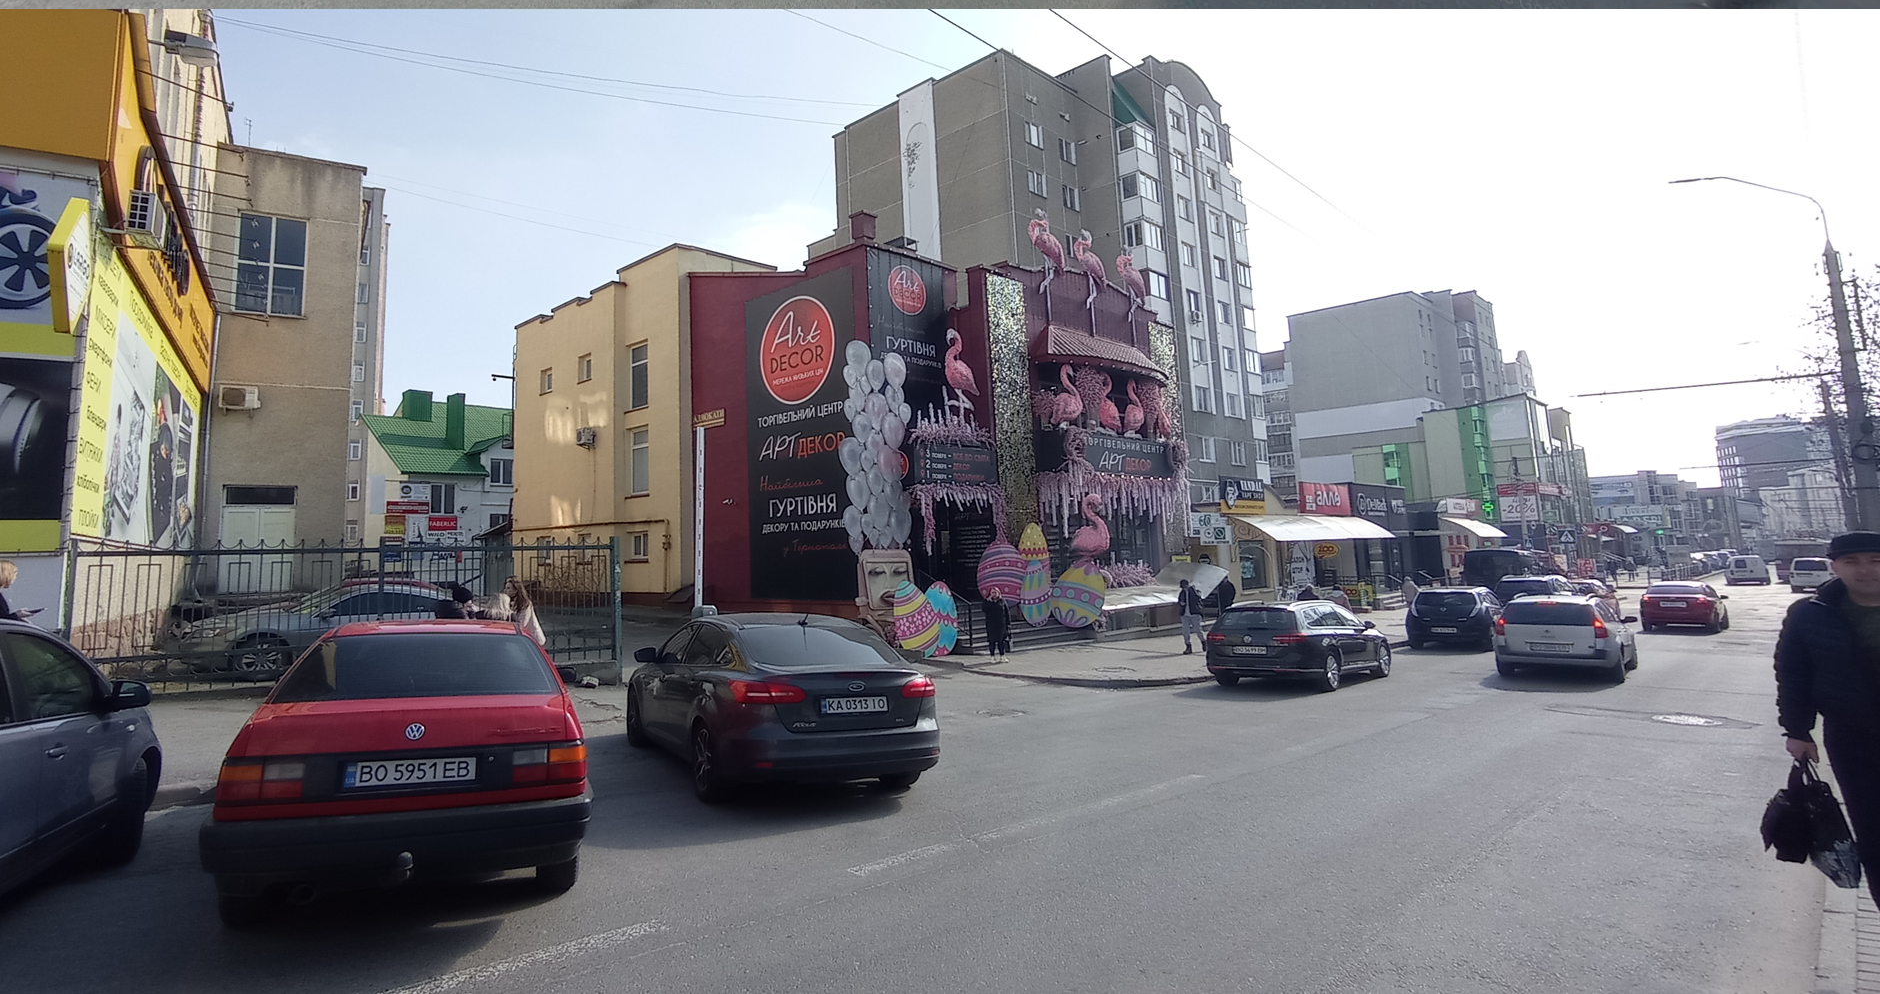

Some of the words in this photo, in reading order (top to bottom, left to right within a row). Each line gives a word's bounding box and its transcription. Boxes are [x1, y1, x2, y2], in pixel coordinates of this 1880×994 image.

[894, 270, 920, 291] Art
[893, 288, 922, 301] DECOR
[771, 311, 821, 353] Art
[886, 335, 936, 358] ГУРТІВНЯ
[770, 345, 824, 374] DECOR
[757, 405, 816, 428] ТОРГІВЕЛЬНИЙ
[817, 400, 844, 418] ЦЕНТР
[759, 431, 802, 461] АРТ
[925, 449, 931, 458] 3
[1084, 436, 1140, 452] ТОРГІВЕЛЬНИЙ
[1142, 444, 1165, 454] ЦЕНТР
[925, 459, 931, 468] 2
[1099, 451, 1126, 471] АРТ
[1125, 457, 1152, 472] ДЕКОР
[926, 470, 930, 478] 1
[769, 493, 837, 517] ГУРТІВНЯ
[762, 521, 789, 534] ДЕКОРУ
[790, 521, 800, 531] ТА
[800, 518, 846, 532] ПОДАРУНКІВ
[827, 700, 844, 711] KA
[845, 699, 869, 710] 0313
[359, 764, 388, 783] BO
[393, 762, 438, 782] 5951
[443, 761, 470, 778] EB
